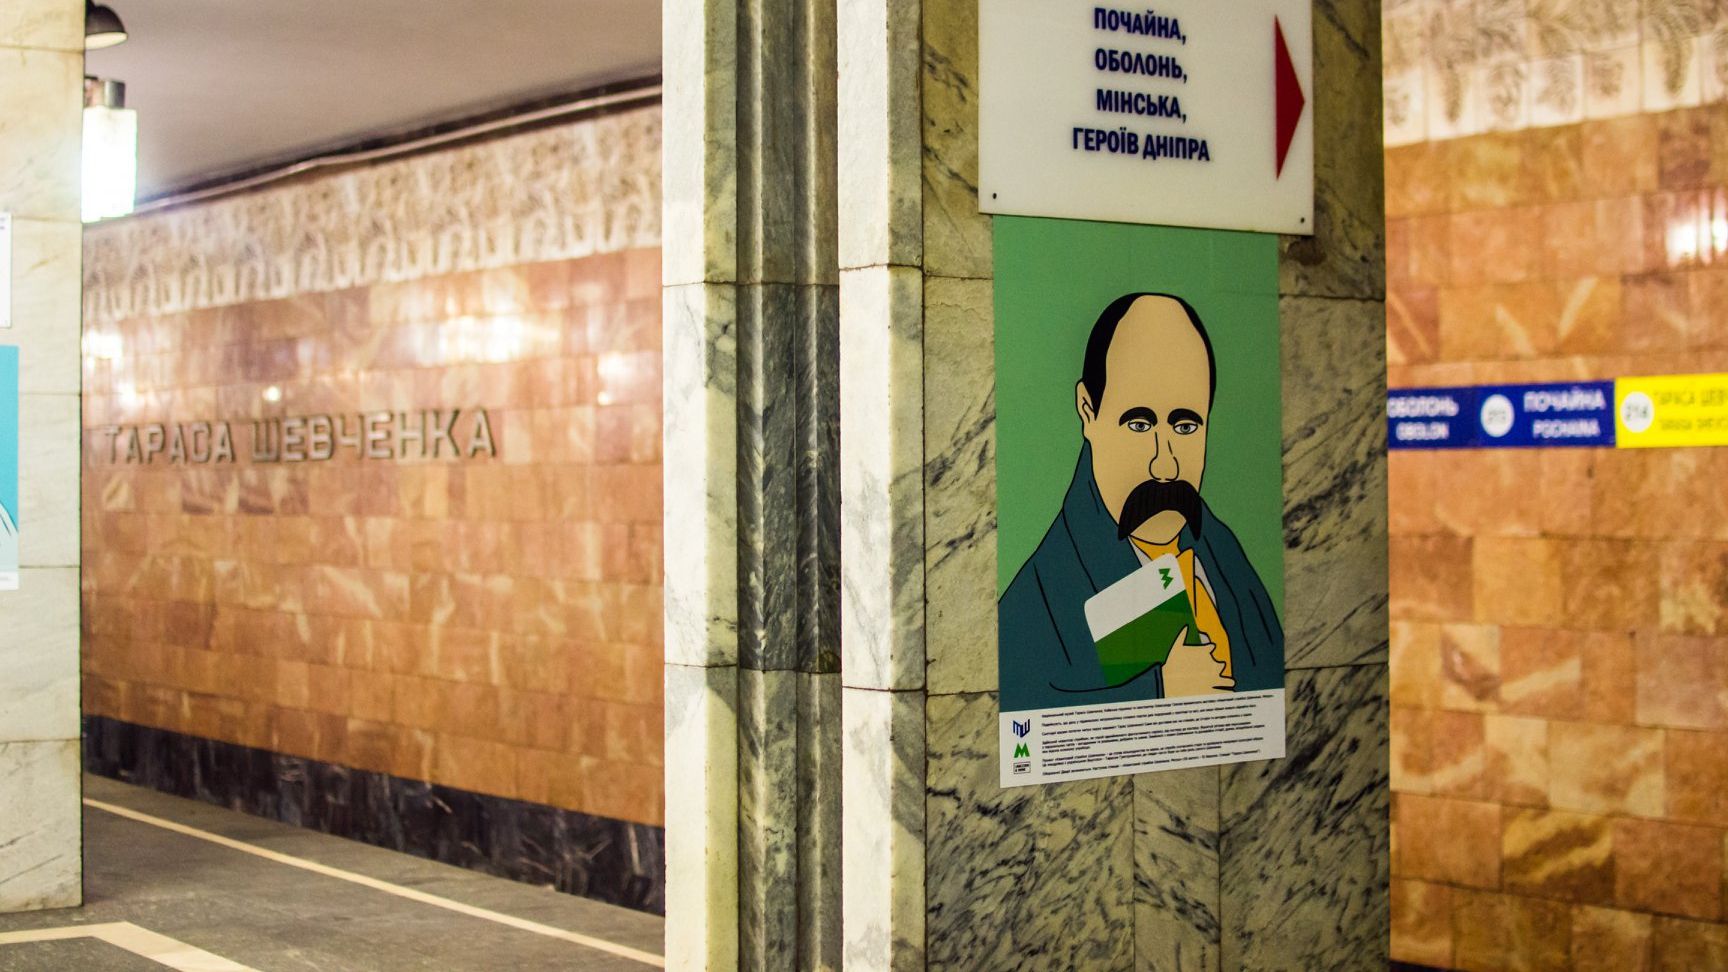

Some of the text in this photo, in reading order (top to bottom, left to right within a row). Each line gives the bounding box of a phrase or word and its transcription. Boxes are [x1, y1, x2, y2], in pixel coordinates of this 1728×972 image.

[1094, 8, 1187, 45] ПОЧАЙНА,
[1095, 48, 1188, 83] ОБОЛОНЬ,
[1096, 89, 1187, 123] МІНСЬКА,
[1073, 126, 1210, 162] ГЕРОЇВ ДНІПРА
[105, 407, 497, 464] ТАРАСА ШЕВЧЕНКА
